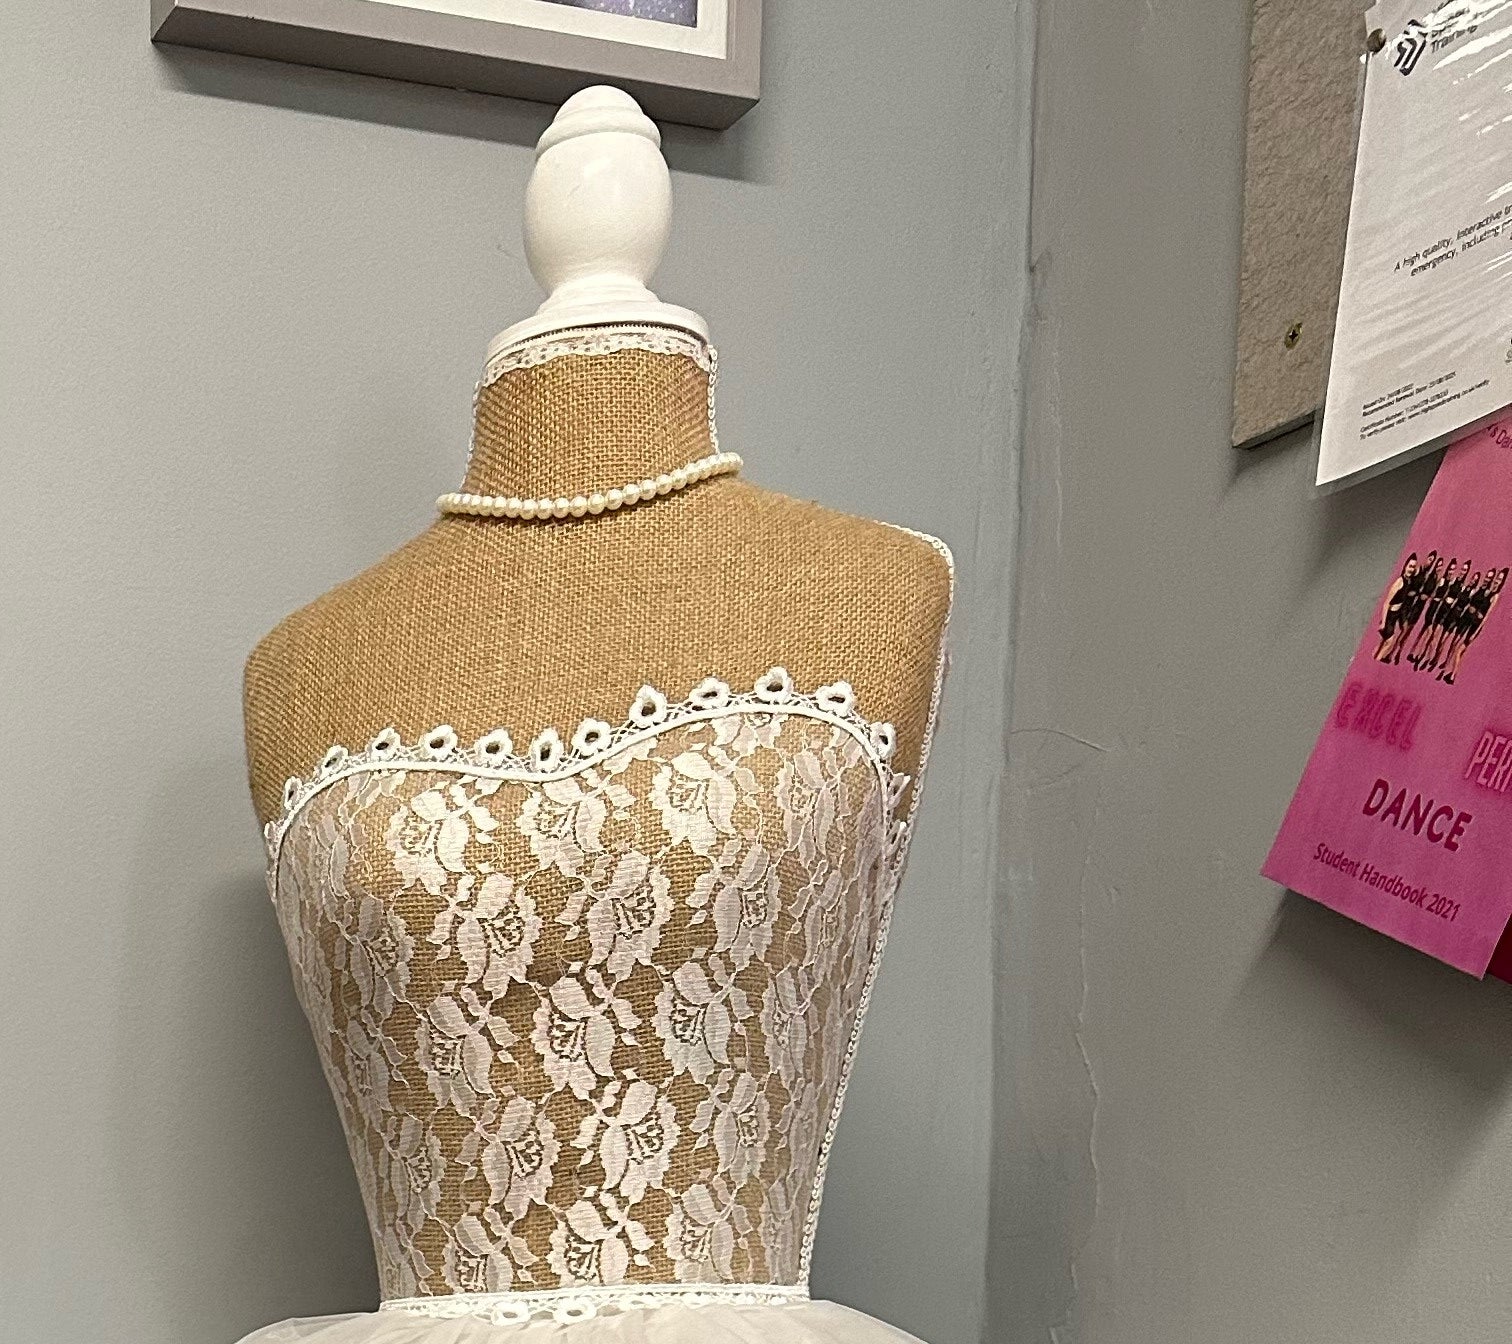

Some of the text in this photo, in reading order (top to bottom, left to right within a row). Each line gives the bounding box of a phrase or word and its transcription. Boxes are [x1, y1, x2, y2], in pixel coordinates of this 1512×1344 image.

[1362, 778, 1473, 852] DANCE
[1313, 842, 1462, 922] Student Handbook 2021
